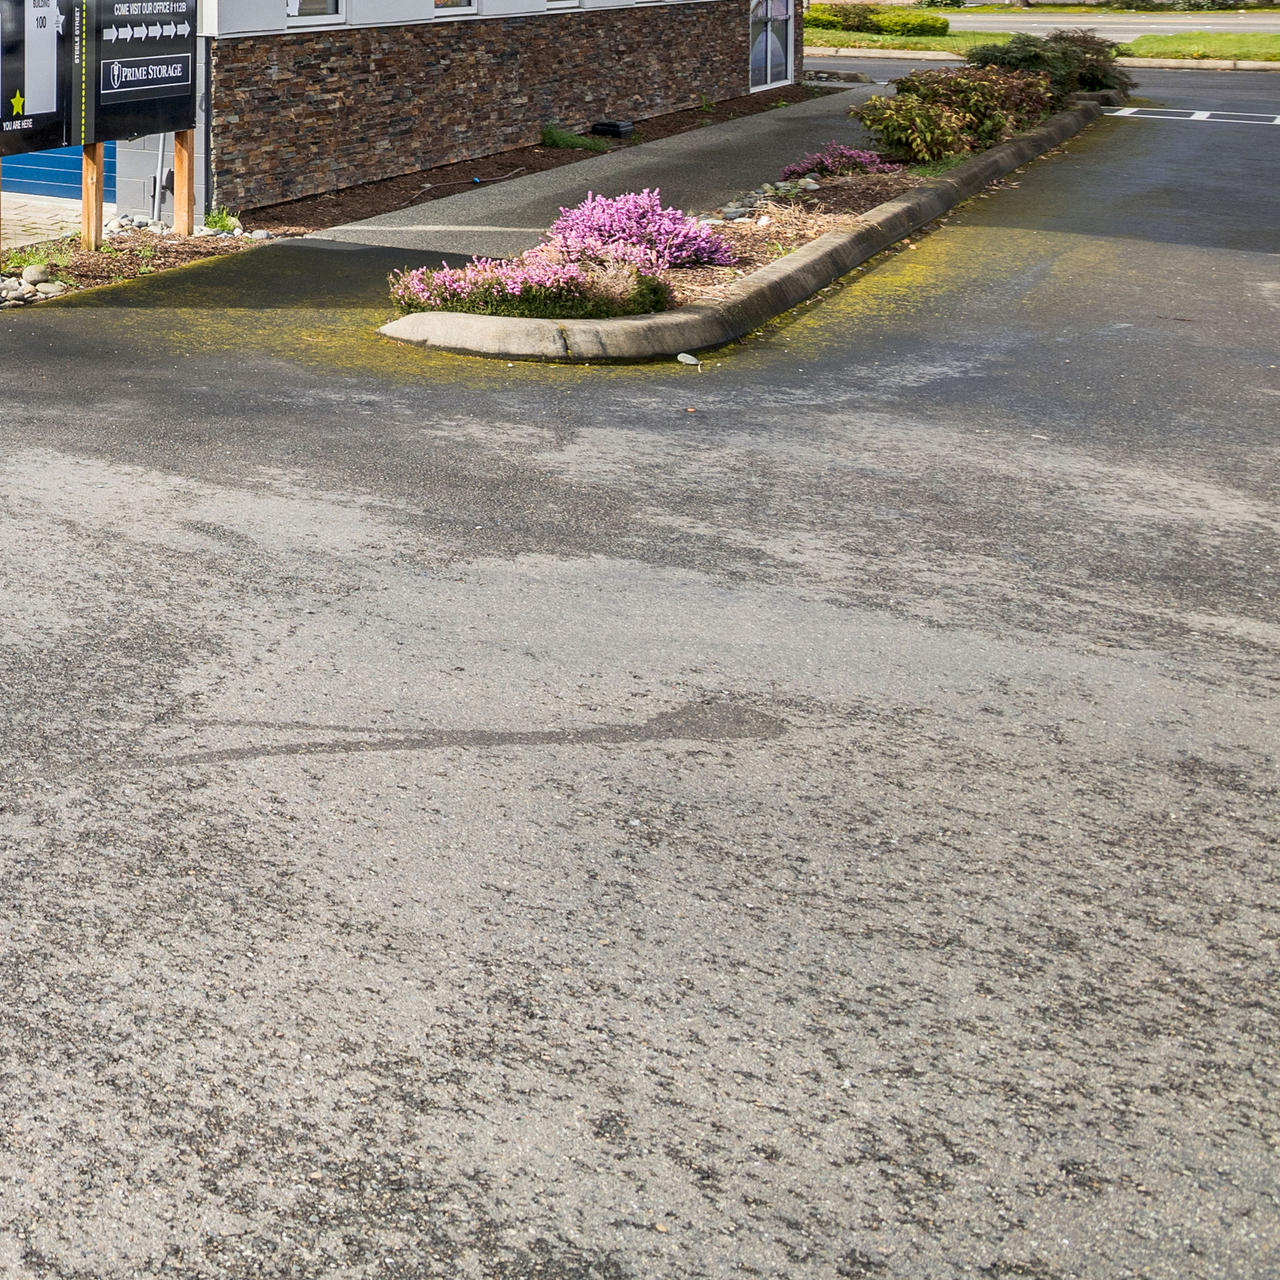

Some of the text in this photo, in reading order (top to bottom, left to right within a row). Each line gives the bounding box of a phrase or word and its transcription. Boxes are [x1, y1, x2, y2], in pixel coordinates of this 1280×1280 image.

[32, 0, 50, 8] BUILDING
[114, 3, 129, 15] COME
[130, 3, 141, 14] VISIT
[142, 2, 153, 14] OUR
[153, 2, 170, 13] OFFICE
[36, 16, 46, 29] 100
[121, 64, 182, 81] PRIME STORAGE
[3, 119, 33, 131] YOU ARE HERE
